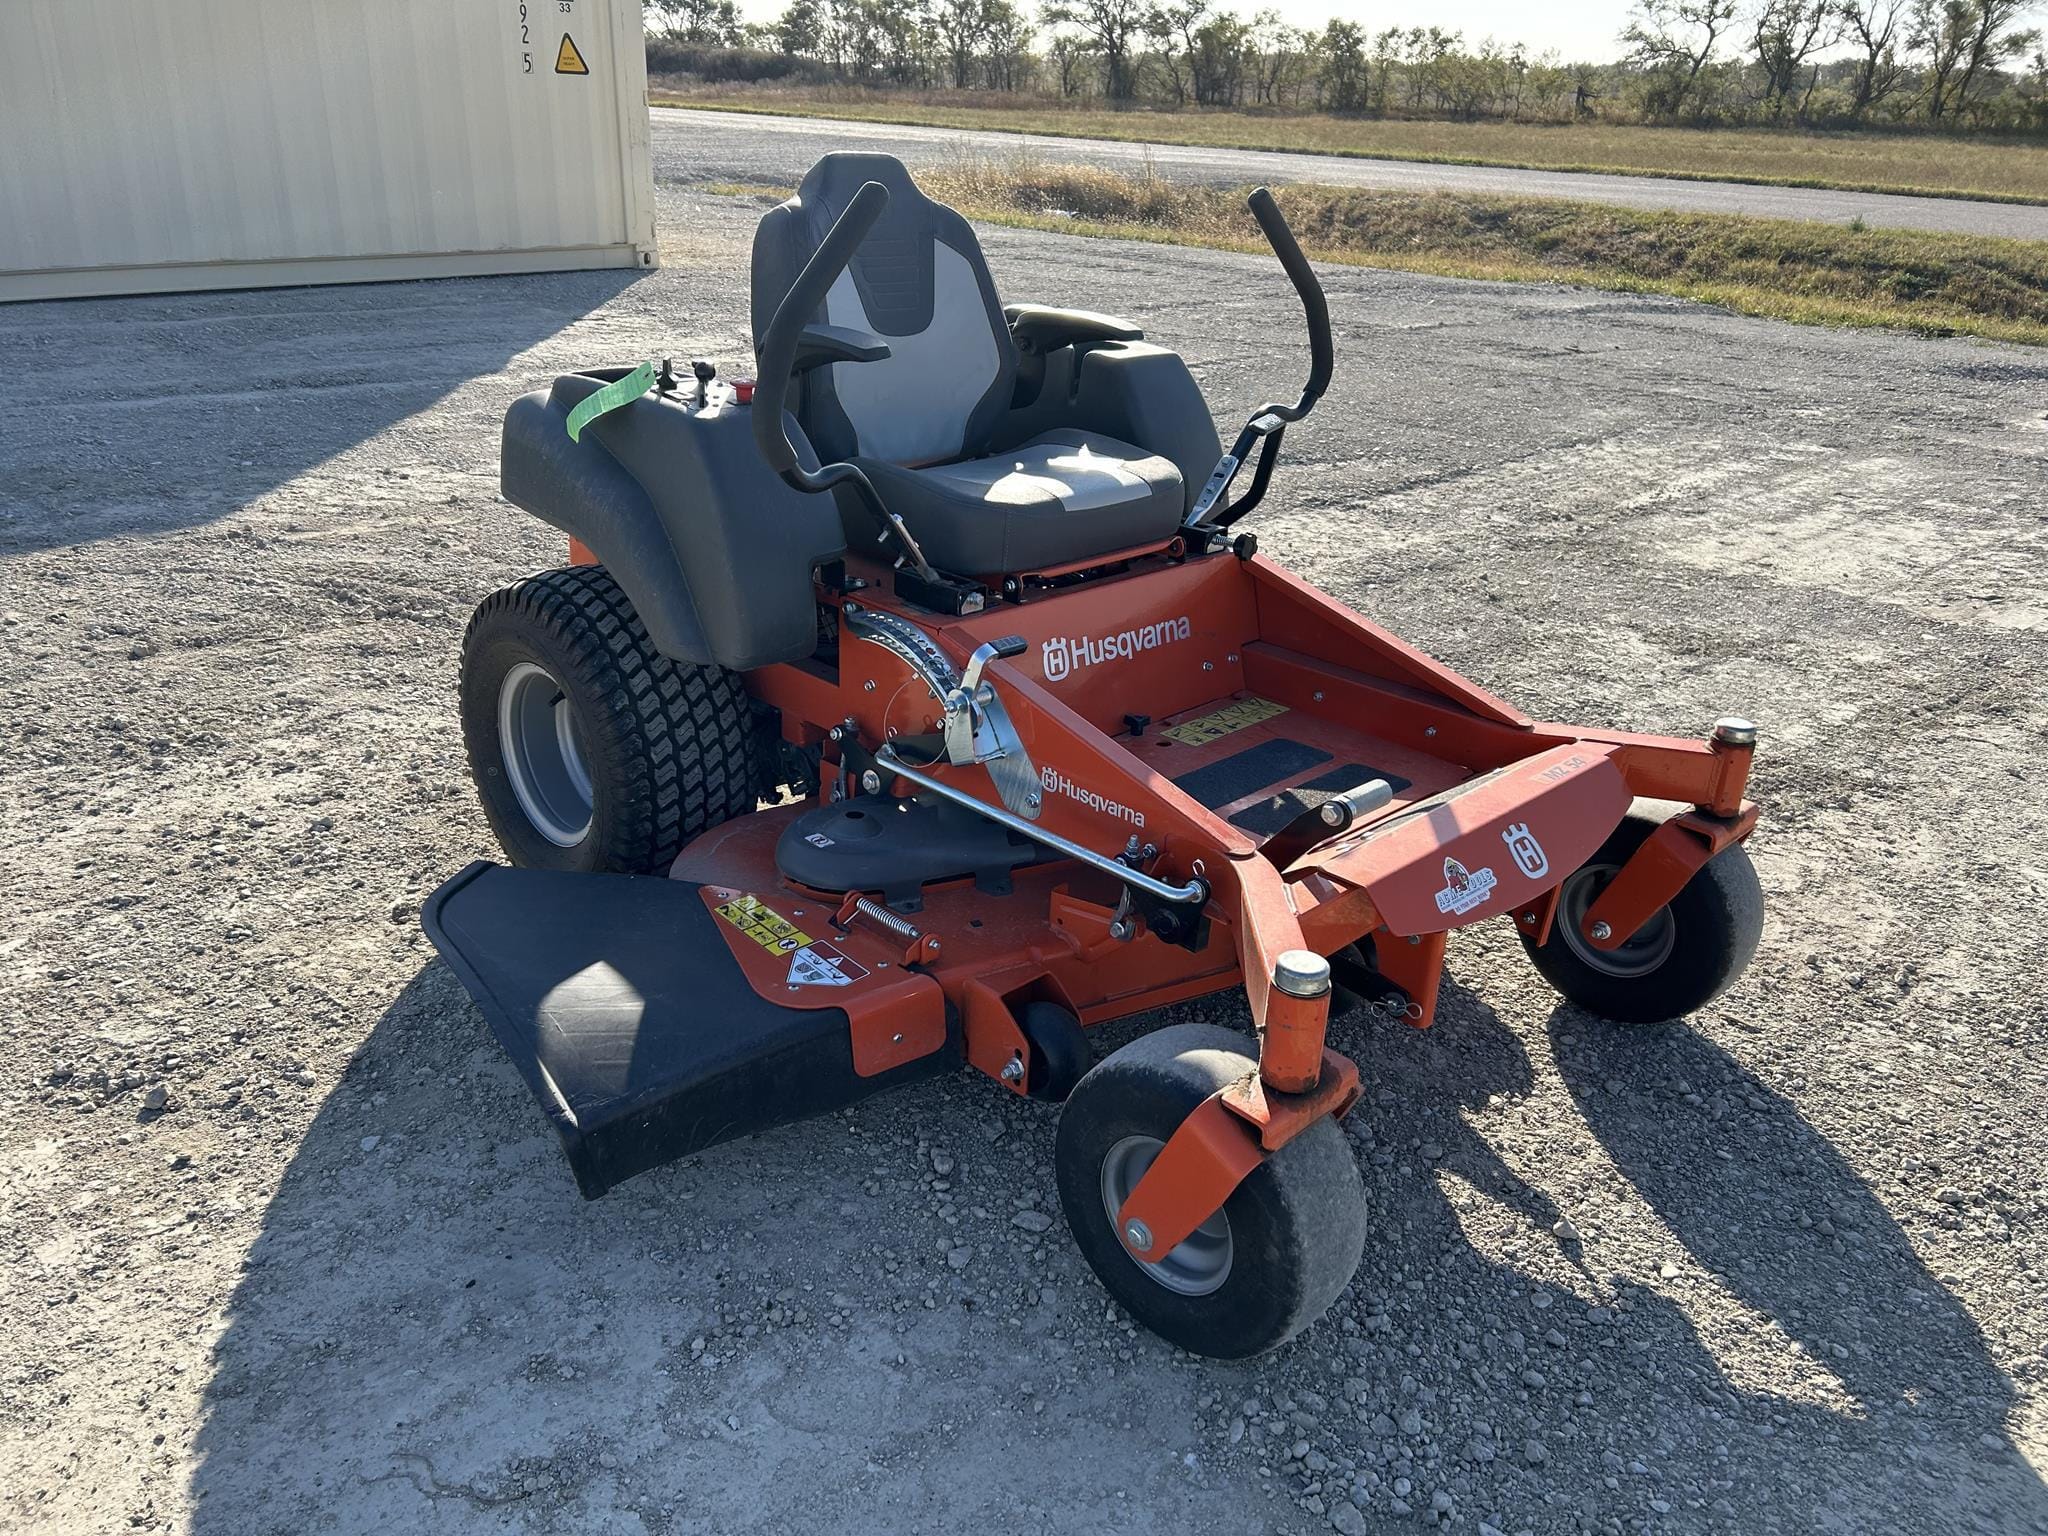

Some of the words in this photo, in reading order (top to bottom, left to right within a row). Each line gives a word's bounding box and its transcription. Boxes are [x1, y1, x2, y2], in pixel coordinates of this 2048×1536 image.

[559, 2, 571, 13] 33
[1070, 616, 1191, 670] Husqvarna
[1058, 775, 1146, 829] Husqvarna
[1438, 885, 1464, 907] ACME
